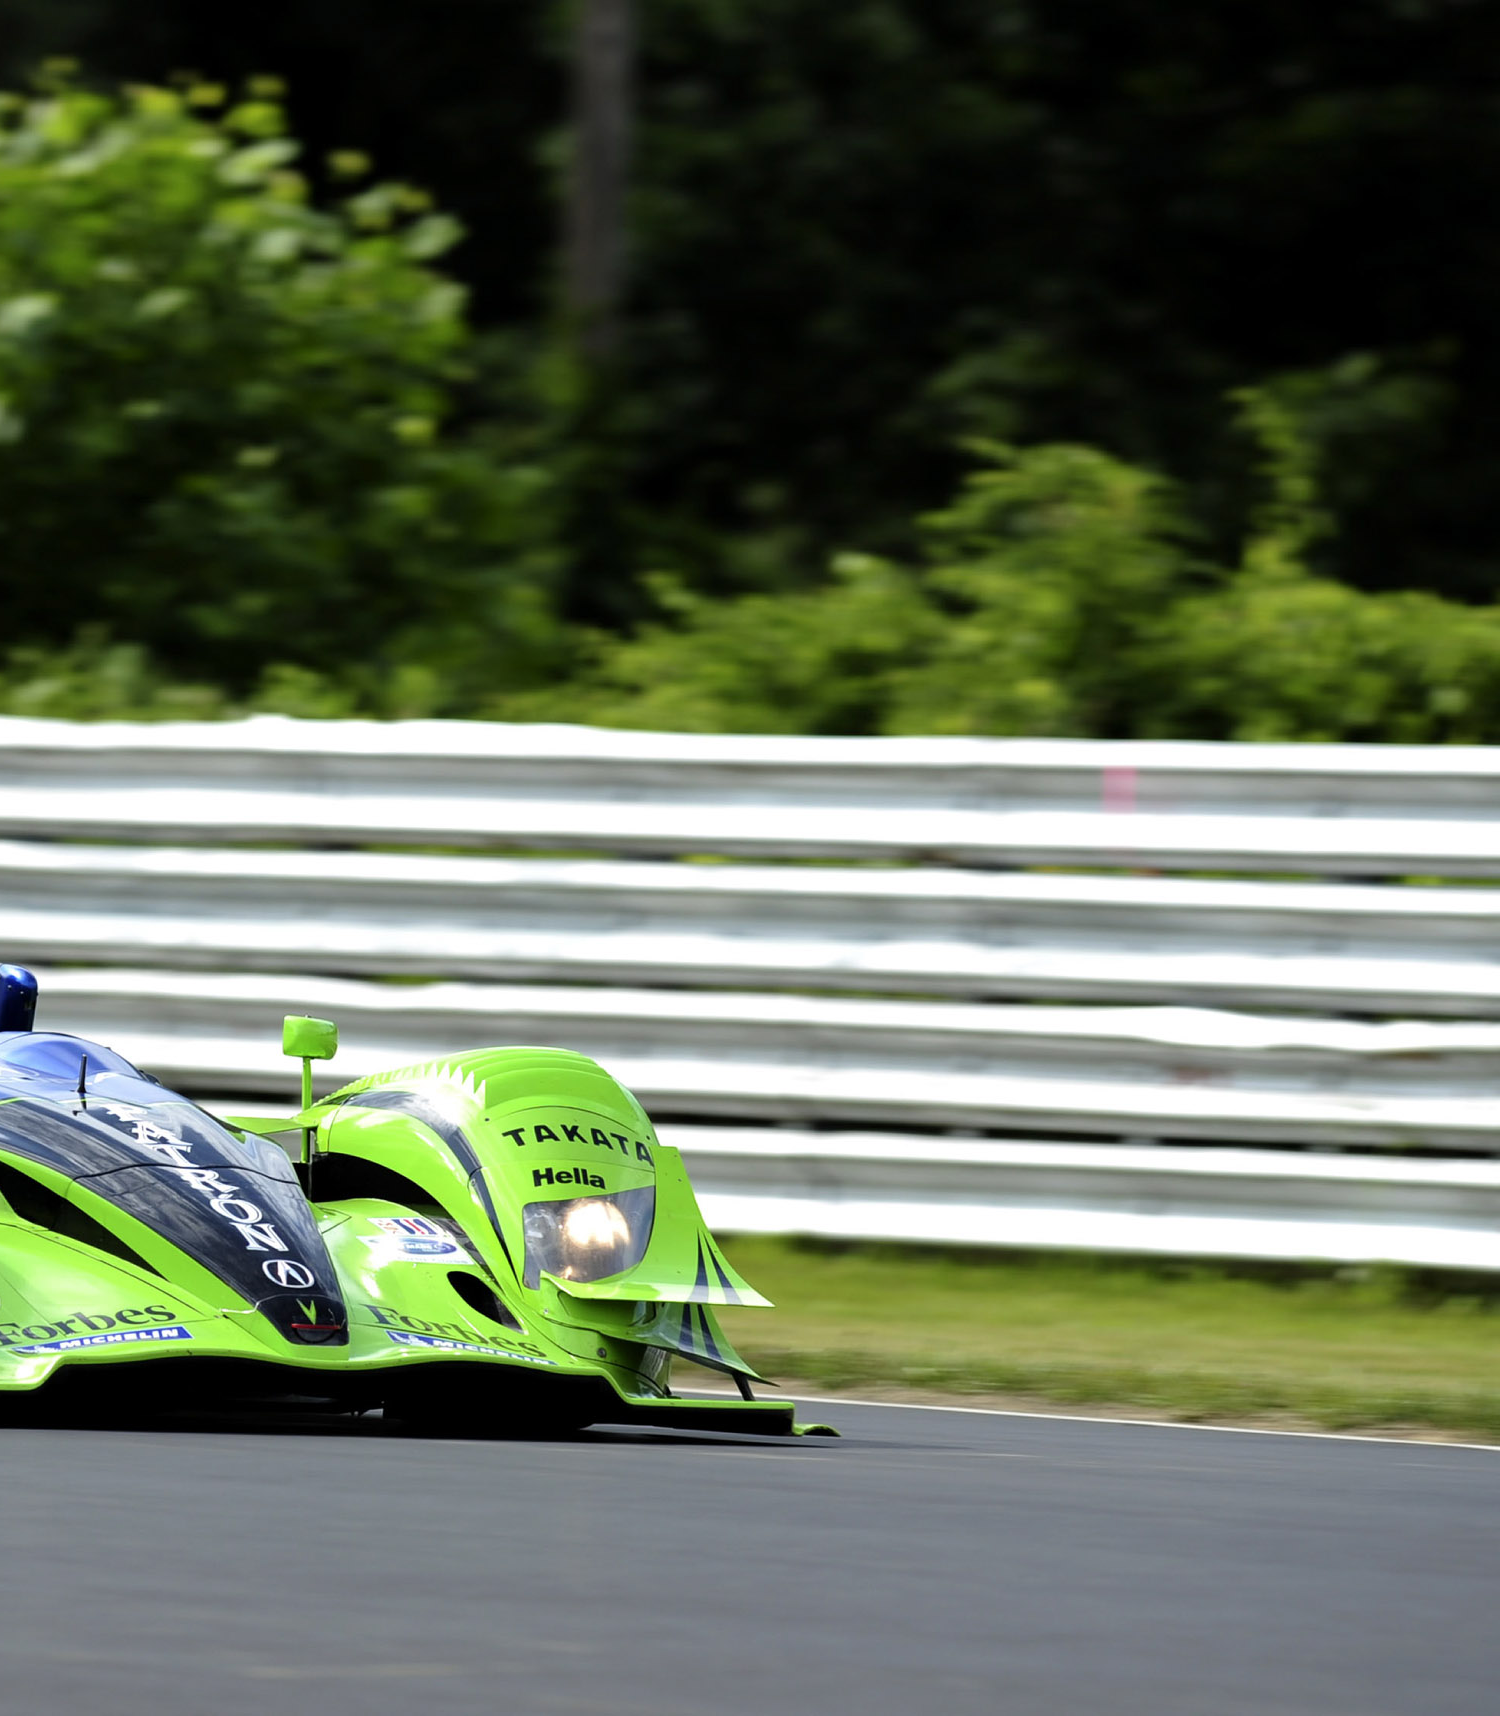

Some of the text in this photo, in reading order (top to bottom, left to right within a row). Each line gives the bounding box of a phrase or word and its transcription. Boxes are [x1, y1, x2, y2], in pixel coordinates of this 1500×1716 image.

[501, 1124, 655, 1168] TAKATA
[532, 1167, 606, 1190] Hella
[60, 1328, 179, 1349] MICHELIN
[358, 1303, 547, 1358] Forbes
[432, 1339, 550, 1366] MICHELIN
